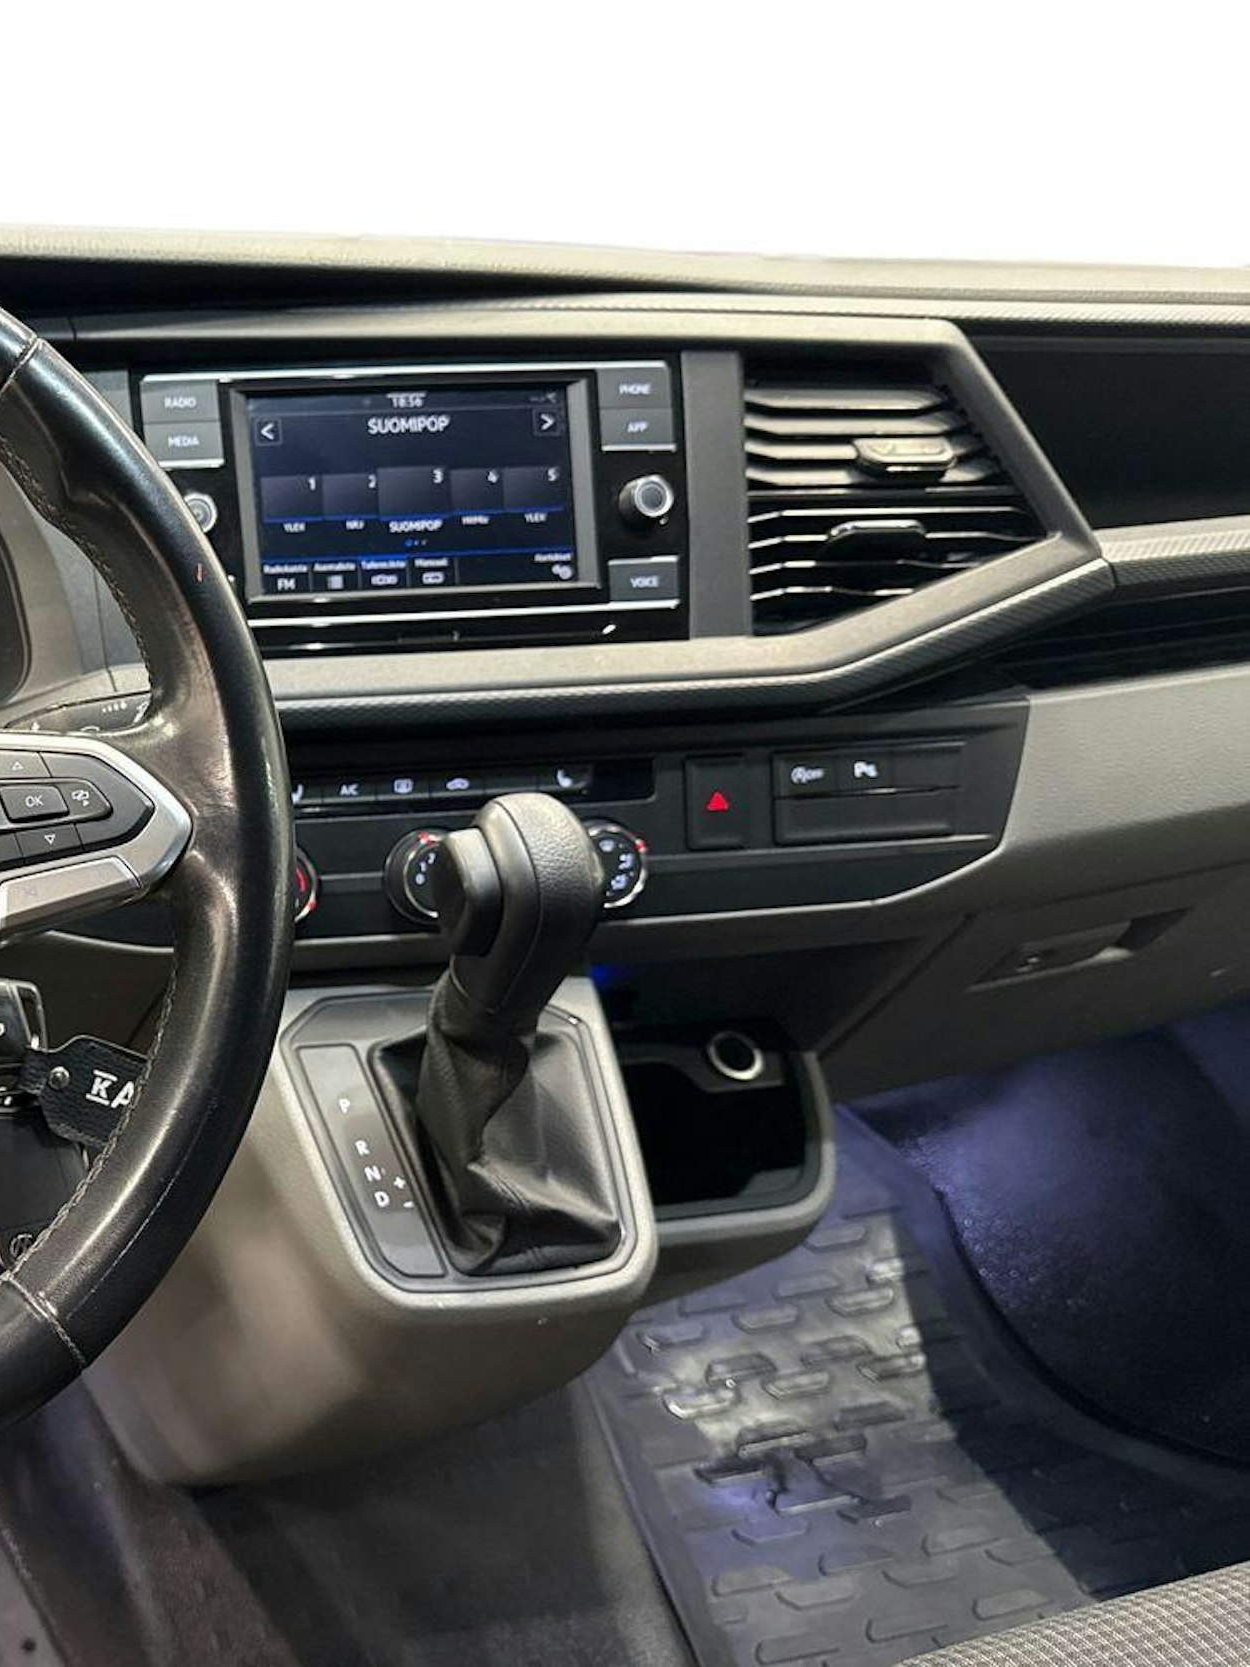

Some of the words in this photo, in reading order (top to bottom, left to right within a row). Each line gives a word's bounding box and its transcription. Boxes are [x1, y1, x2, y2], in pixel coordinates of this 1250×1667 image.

[619, 383, 652, 395] PHONE
[164, 397, 197, 408] RADIO
[368, 416, 450, 434] SUOMIPOP
[627, 421, 648, 433] APP
[168, 435, 199, 447] MEDIA
[367, 474, 377, 489] 2
[432, 469, 444, 484] 3
[487, 471, 499, 483] 4
[547, 468, 557, 482] 5
[308, 477, 316, 491] 1
[389, 519, 443, 533] SUOMIPOP
[277, 578, 297, 591] FM
[630, 577, 659, 588] VOICE
[340, 783, 359, 796] AC
[25, 794, 43, 808] OK
[338, 1097, 351, 1114] P
[355, 1139, 369, 1156] R
[364, 1165, 381, 1182] N
[374, 1191, 390, 1208] D
